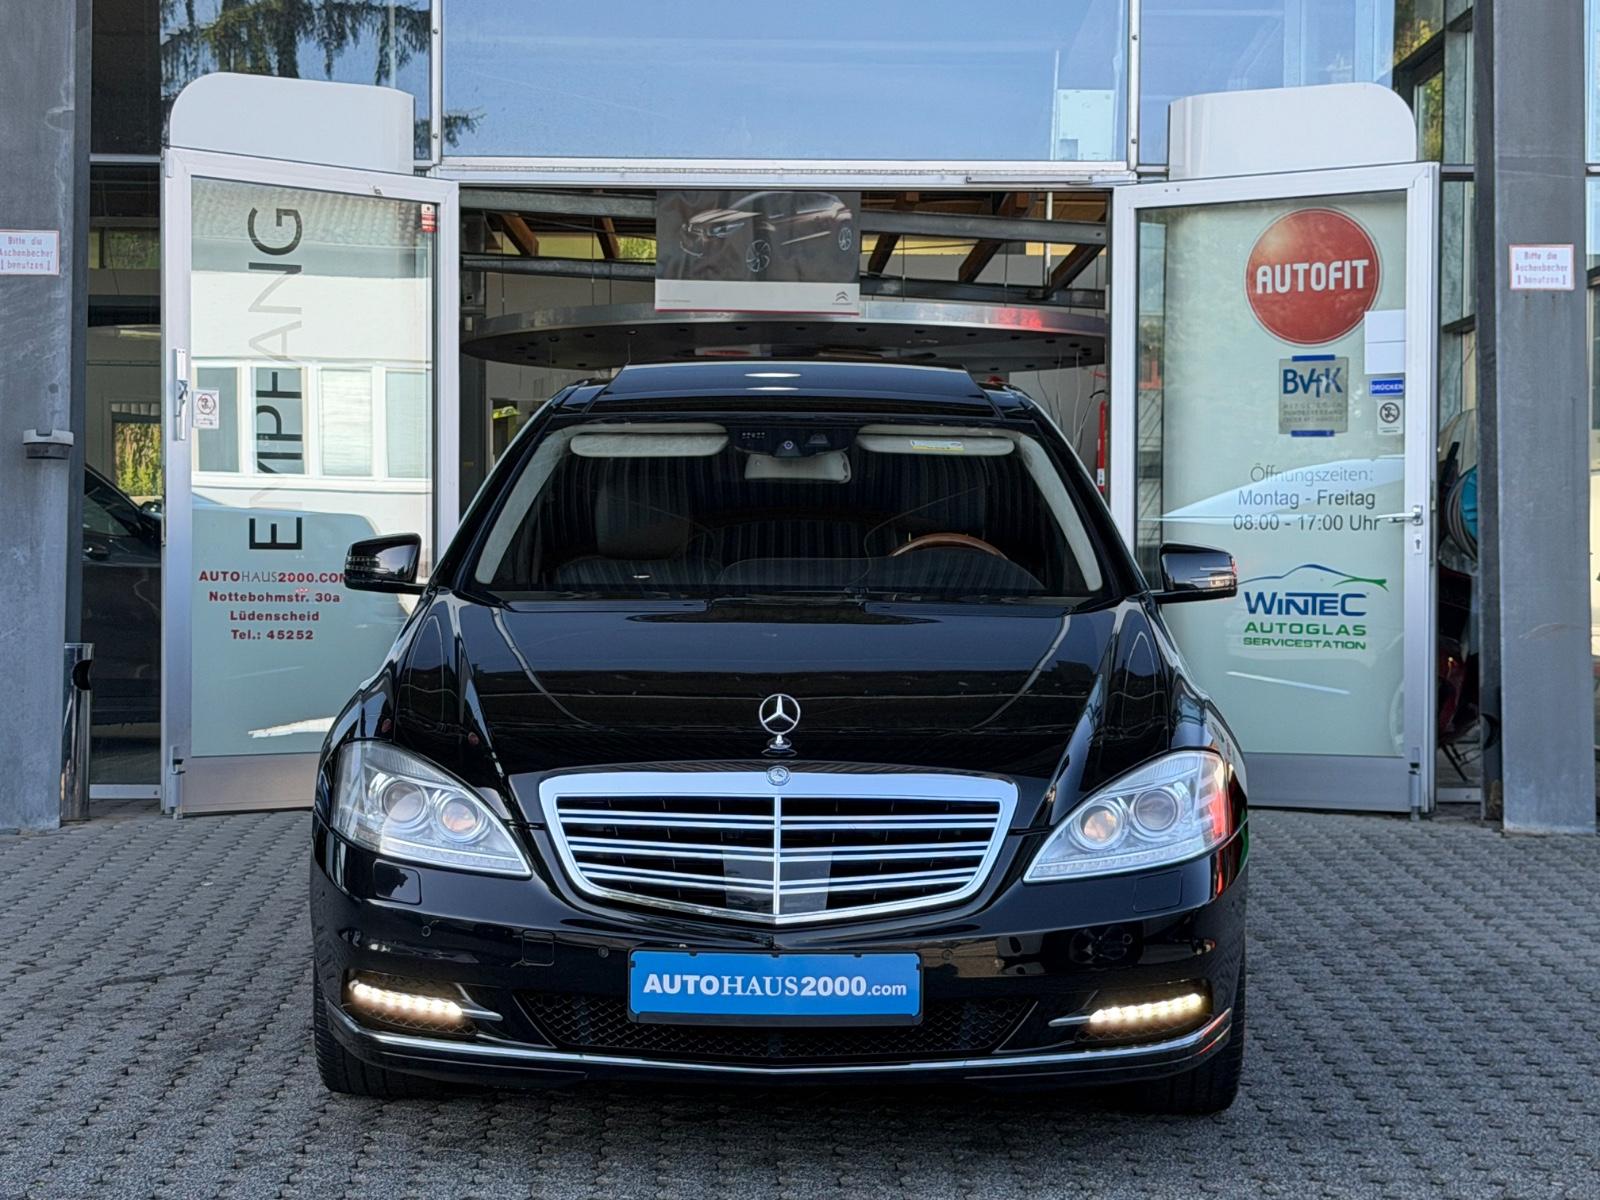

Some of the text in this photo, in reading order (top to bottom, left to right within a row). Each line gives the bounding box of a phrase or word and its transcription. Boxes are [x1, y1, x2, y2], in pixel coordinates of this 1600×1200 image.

[1256, 259, 1369, 294] AUTOFIT
[1250, 463, 1374, 487] Öffnungszeiten:
[1238, 490, 1299, 509] Montag
[1317, 489, 1376, 509] Freitag
[1233, 514, 1280, 531] 08:00
[1298, 514, 1344, 531] 17:00
[1349, 514, 1381, 531] Uhr
[208, 591, 341, 603] Nottebohmstr. 30a
[230, 610, 320, 621] Lüdenscheid
[231, 629, 314, 640] Tel.: 45252
[1244, 621, 1367, 636] AUTOGLAS
[1243, 636, 1367, 650] SERVICESTATION
[643, 973, 907, 996] AUTOHAUS2000.com
